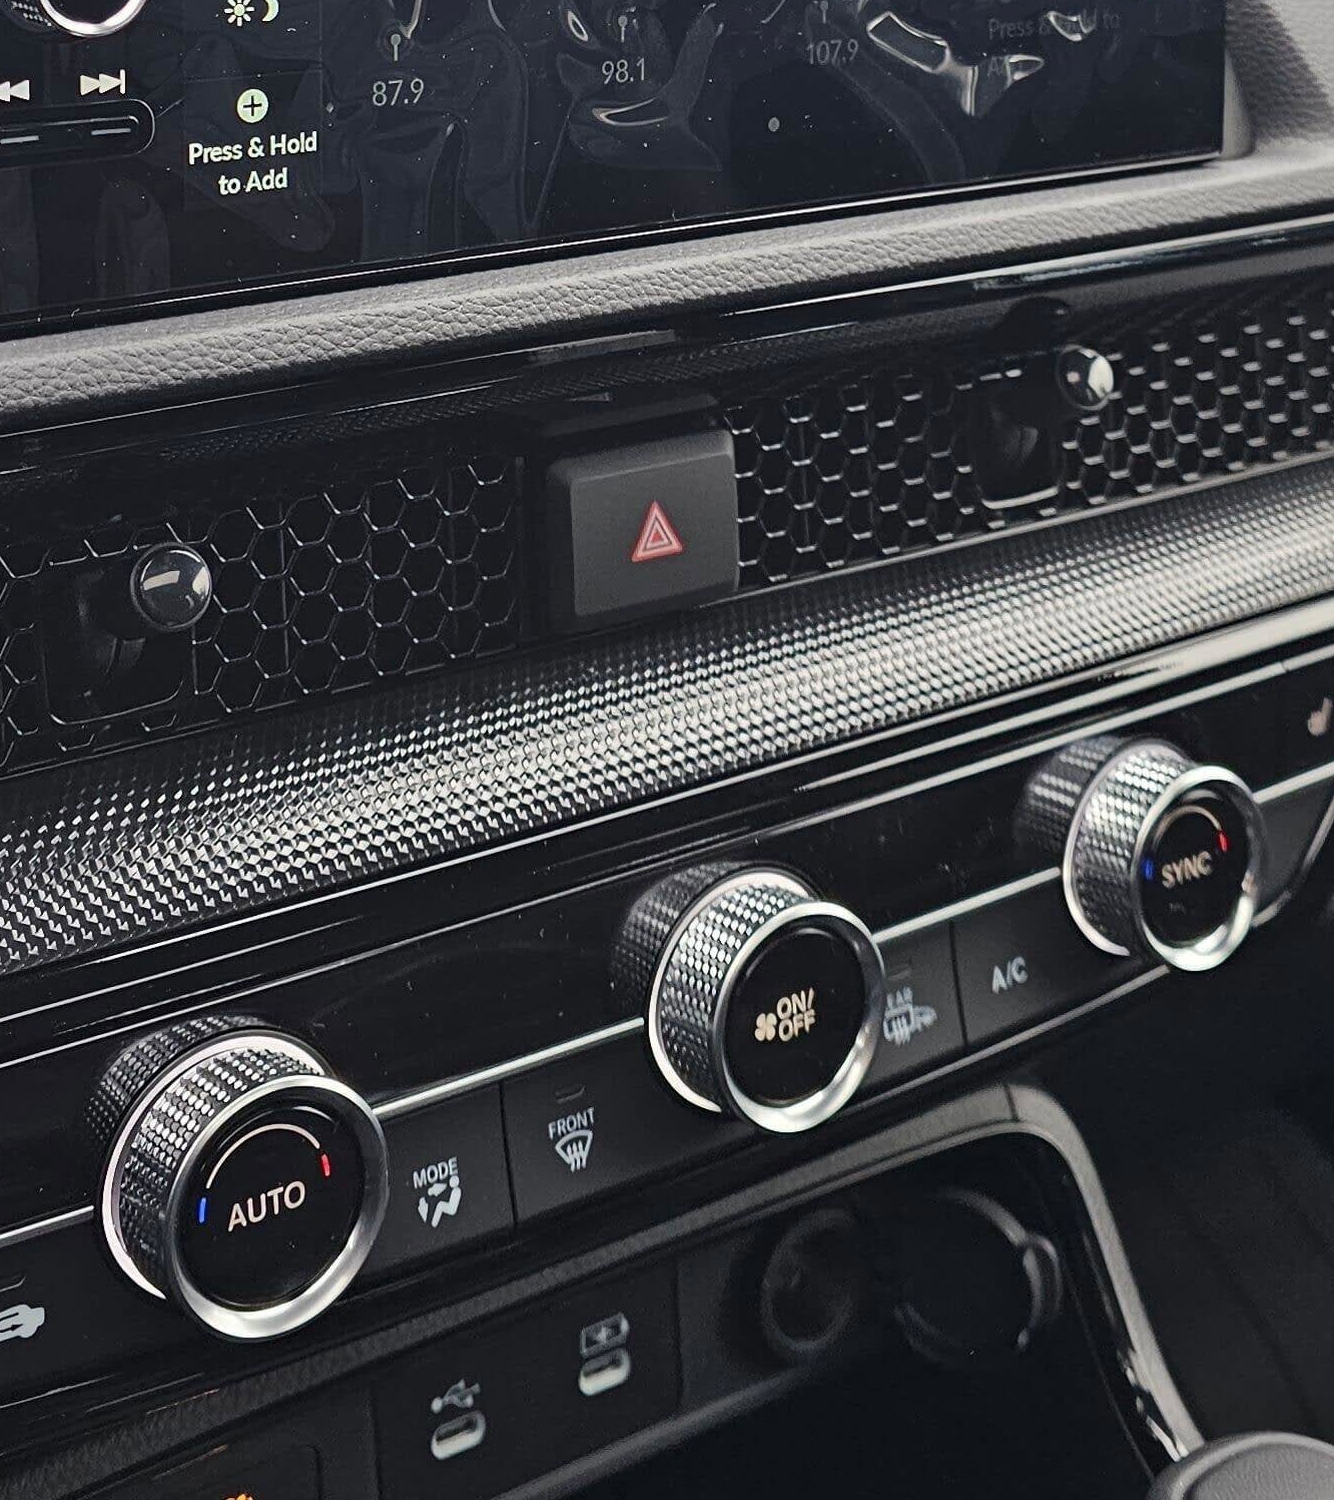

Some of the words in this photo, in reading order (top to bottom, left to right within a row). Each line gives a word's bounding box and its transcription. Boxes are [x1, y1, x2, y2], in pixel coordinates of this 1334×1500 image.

[806, 37, 861, 67] 107.9
[600, 55, 648, 86] 98.1
[371, 76, 425, 107] 87.9
[188, 142, 243, 165] Press
[247, 136, 265, 158] &
[269, 130, 317, 156] Hold
[218, 174, 241, 195] to
[245, 166, 288, 193] Add
[1161, 850, 1213, 889] SYNC
[990, 956, 1029, 993] A/C
[776, 986, 816, 1020] ON/
[778, 1008, 816, 1042] OFF
[547, 1106, 595, 1140] FRONT
[412, 1156, 459, 1189] MODE
[227, 1180, 307, 1232] AUTO
